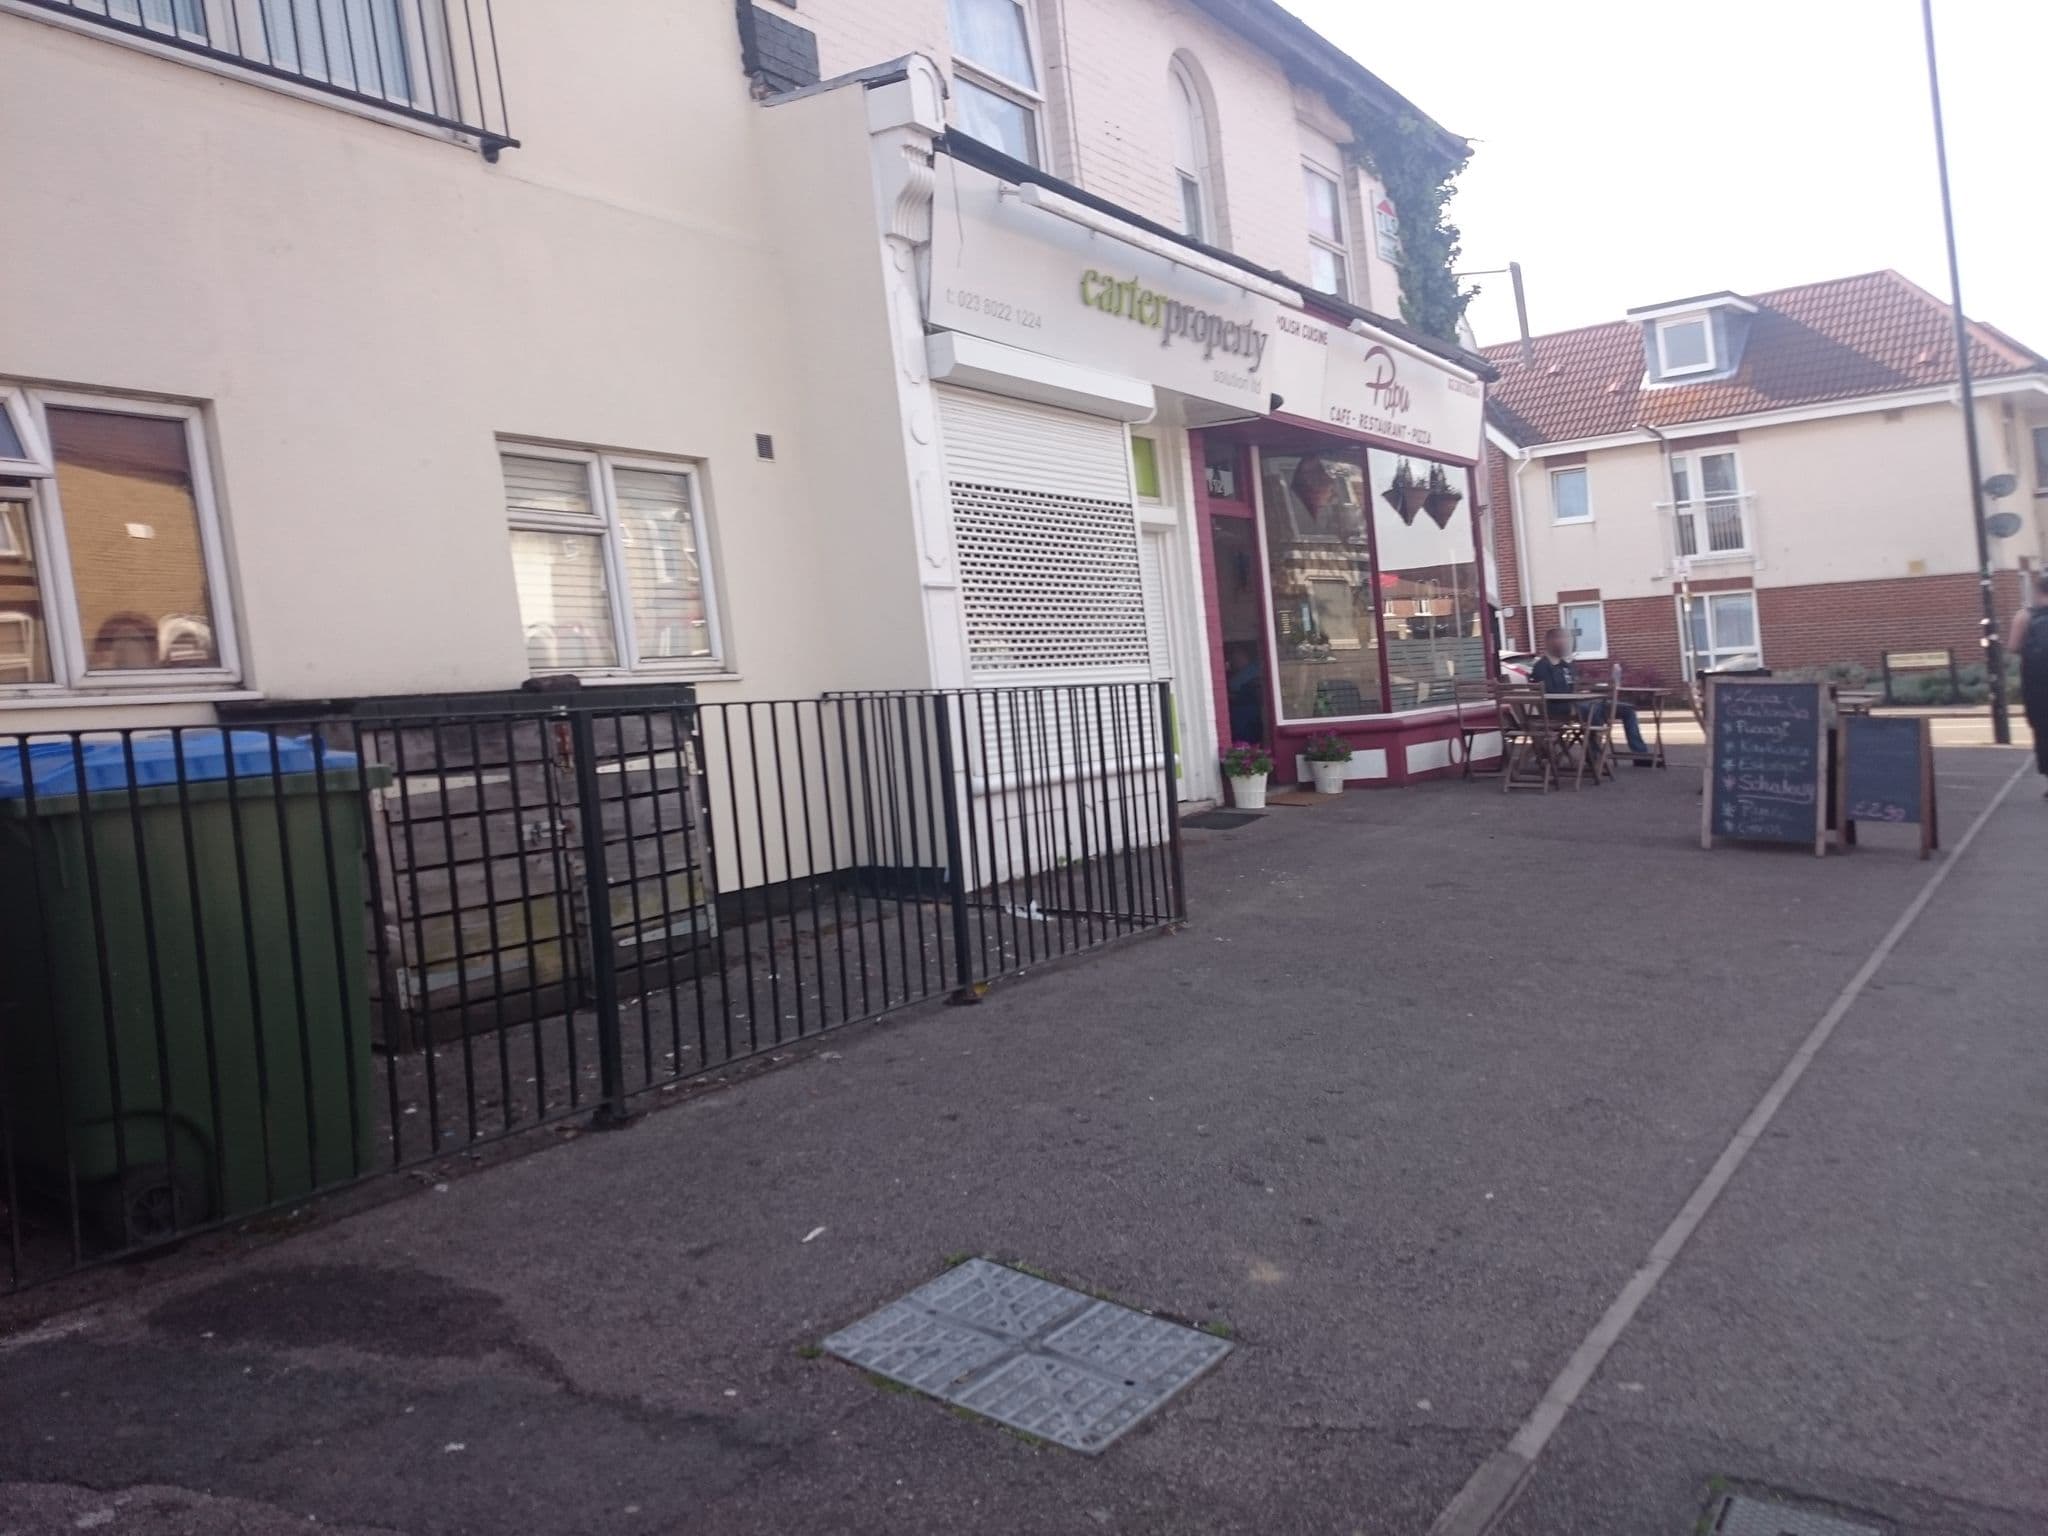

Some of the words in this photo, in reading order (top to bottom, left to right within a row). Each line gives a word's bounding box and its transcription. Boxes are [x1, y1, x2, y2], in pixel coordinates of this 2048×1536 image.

[958, 290, 980, 312] 023
[1015, 308, 1042, 328] 1224
[1359, 413, 1407, 437] RESTAURANT
[1412, 428, 1432, 445] PIZZA
